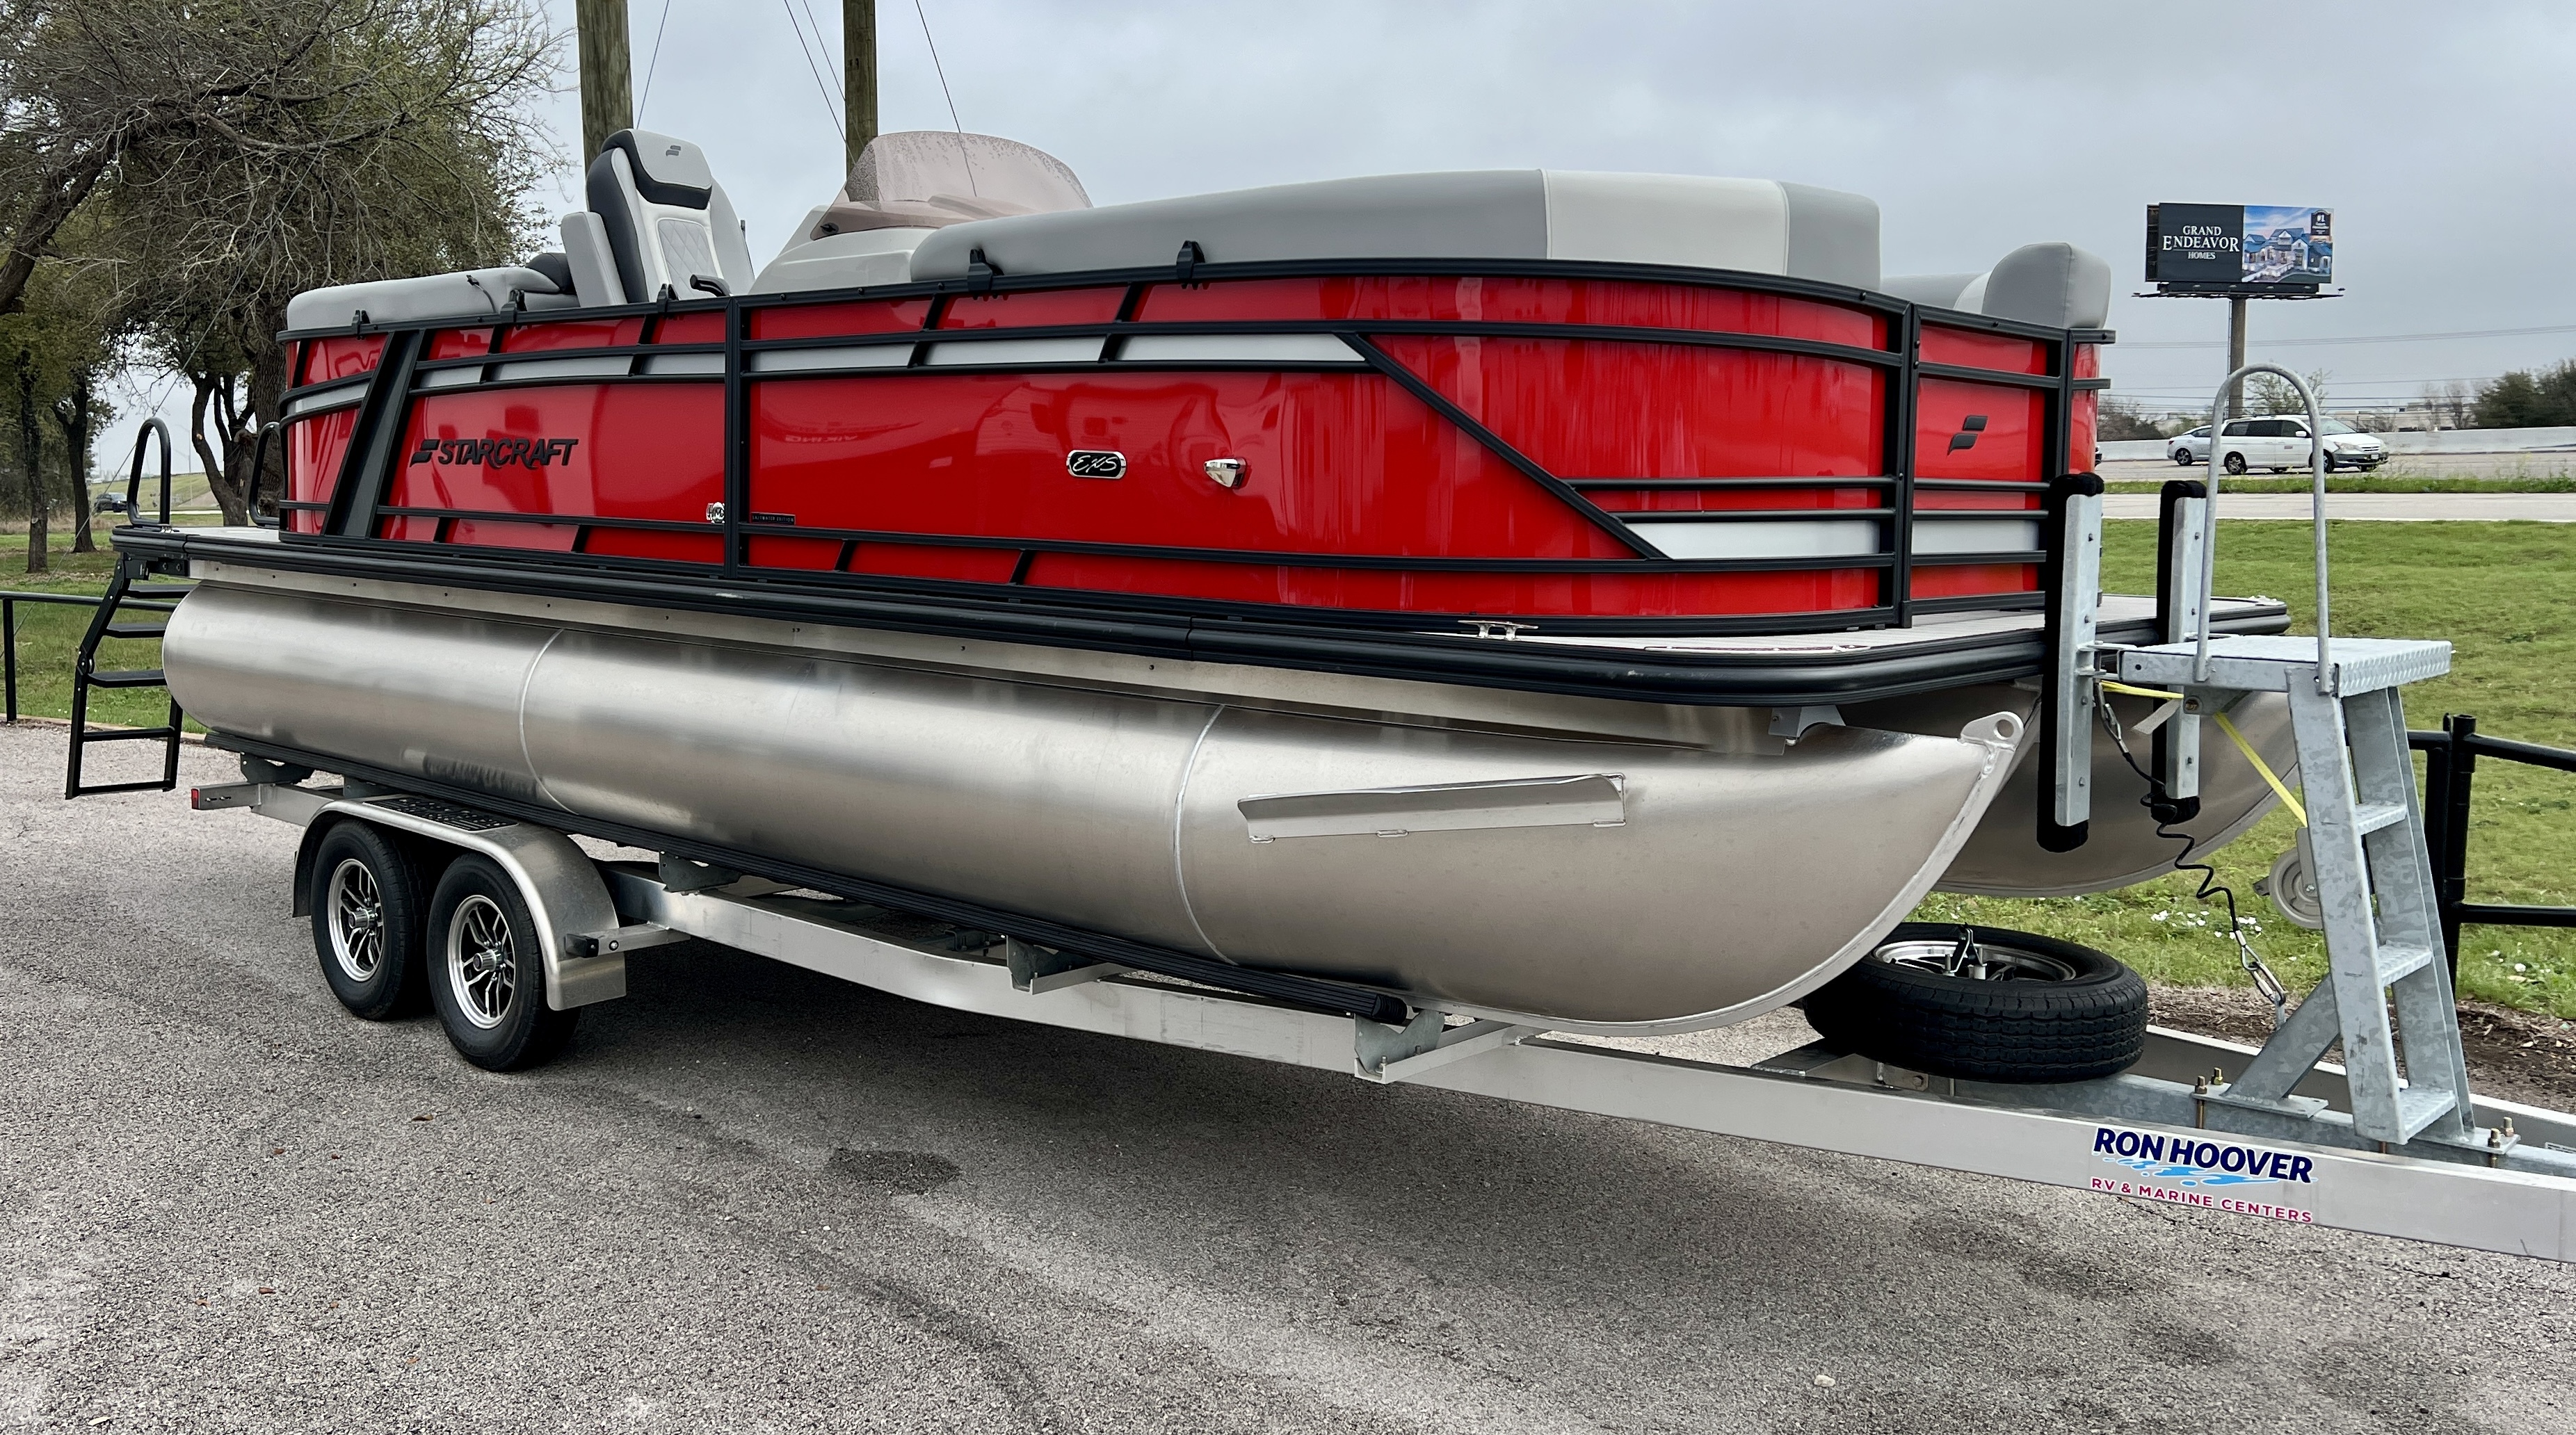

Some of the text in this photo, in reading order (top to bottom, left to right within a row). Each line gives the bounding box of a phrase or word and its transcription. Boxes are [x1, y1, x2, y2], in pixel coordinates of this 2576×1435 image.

[2162, 235, 2240, 252] ENDEAVOR
[2182, 225, 2222, 236] GRAND
[437, 439, 579, 470] STARCRAFT
[2093, 1128, 2313, 1183] RON HOOVER
[2092, 1178, 2312, 1223] RV & MARINE CENTERS
